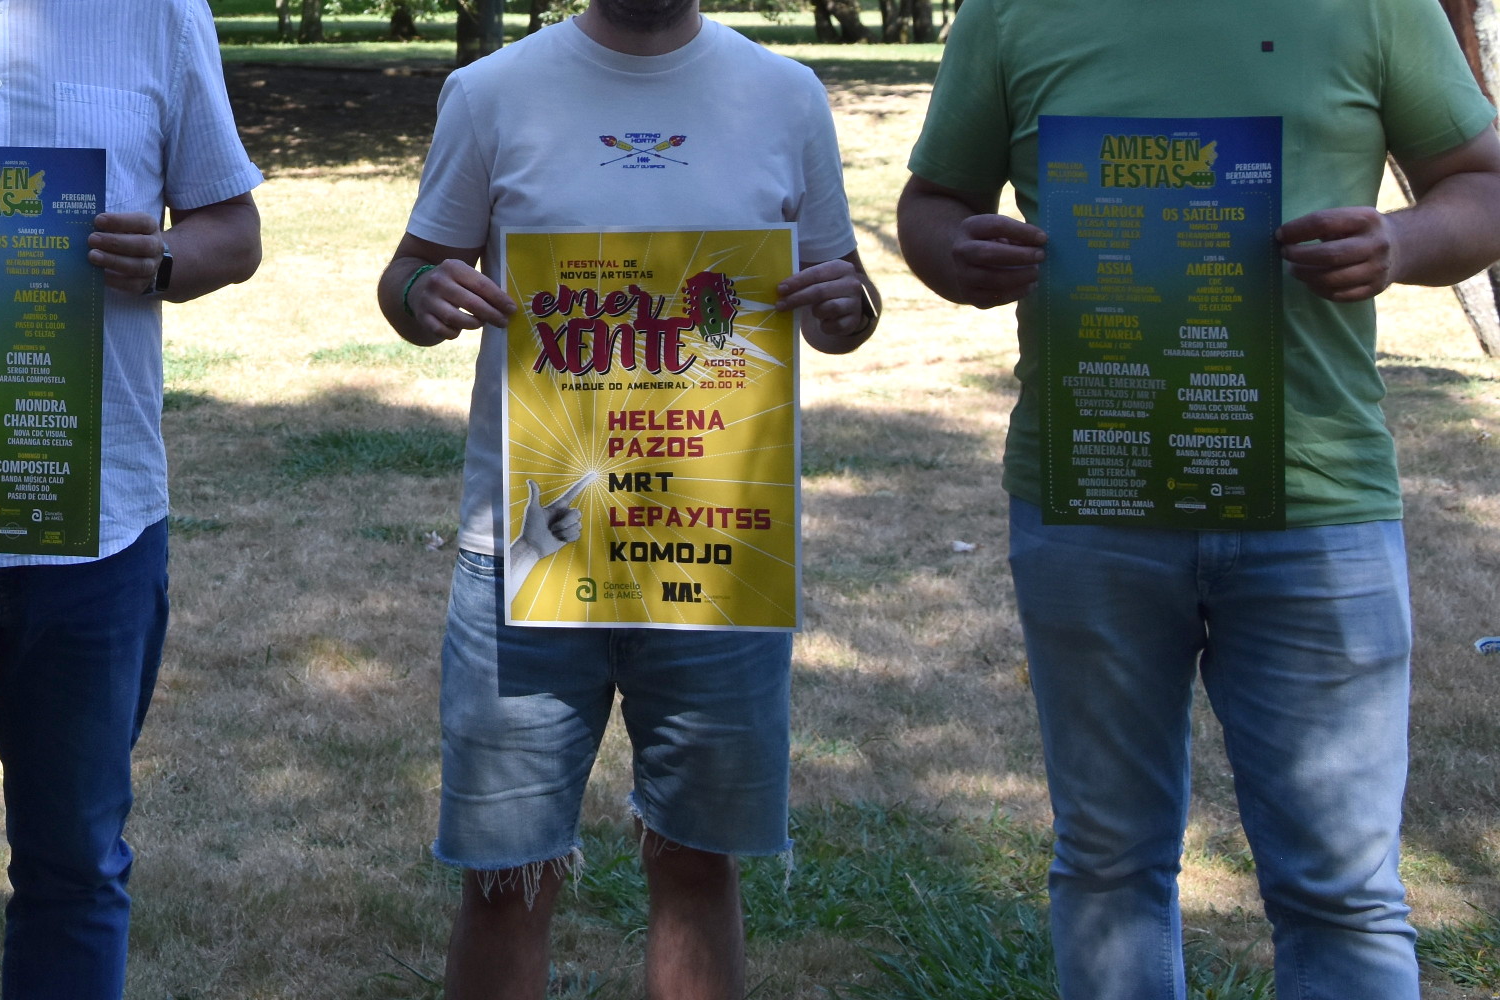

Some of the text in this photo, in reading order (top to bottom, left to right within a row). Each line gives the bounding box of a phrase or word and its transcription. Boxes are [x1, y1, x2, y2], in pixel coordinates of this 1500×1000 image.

[1099, 133, 1200, 162] AMES EN
[2, 166, 30, 191] EN
[1100, 163, 1186, 189] FESTAS
[1072, 204, 1145, 219] MILLAROCK
[1162, 208, 1179, 221] OS
[567, 260, 619, 269] FESTIVAL
[623, 259, 638, 268] DE
[1096, 262, 1134, 276] ASSIA
[560, 270, 654, 280] NOVOS ARTISTAS
[1080, 313, 1140, 328] OLYMPUS
[1179, 325, 1229, 340] CINEMA
[6, 351, 52, 366] CINEMA
[731, 347, 746, 356] 07
[703, 359, 746, 367] AGOSTO
[1078, 361, 1150, 377] PANORAMA
[717, 369, 746, 378] 2025
[1189, 372, 1246, 387] MONDRA
[561, 382, 604, 392] PARQUE
[608, 382, 623, 391] DO
[626, 381, 688, 391] AMENEIRAL
[700, 381, 733, 389] 20.00
[1062, 376, 1107, 388] FESTIVAL
[1177, 388, 1259, 403] CHARLESTON
[14, 398, 67, 413] MONDRA
[3, 413, 78, 429] CHARLESTON
[608, 409, 726, 431] HELENA
[1072, 427, 1151, 445] METRÓPOLIS
[1168, 433, 1252, 449] COMPOSTELA
[608, 436, 704, 458] PAZOS
[609, 506, 772, 530] LEPAYITSS
[609, 541, 733, 566] KOMOJO
[603, 580, 641, 591] Concello
[603, 591, 643, 600] de AMES
